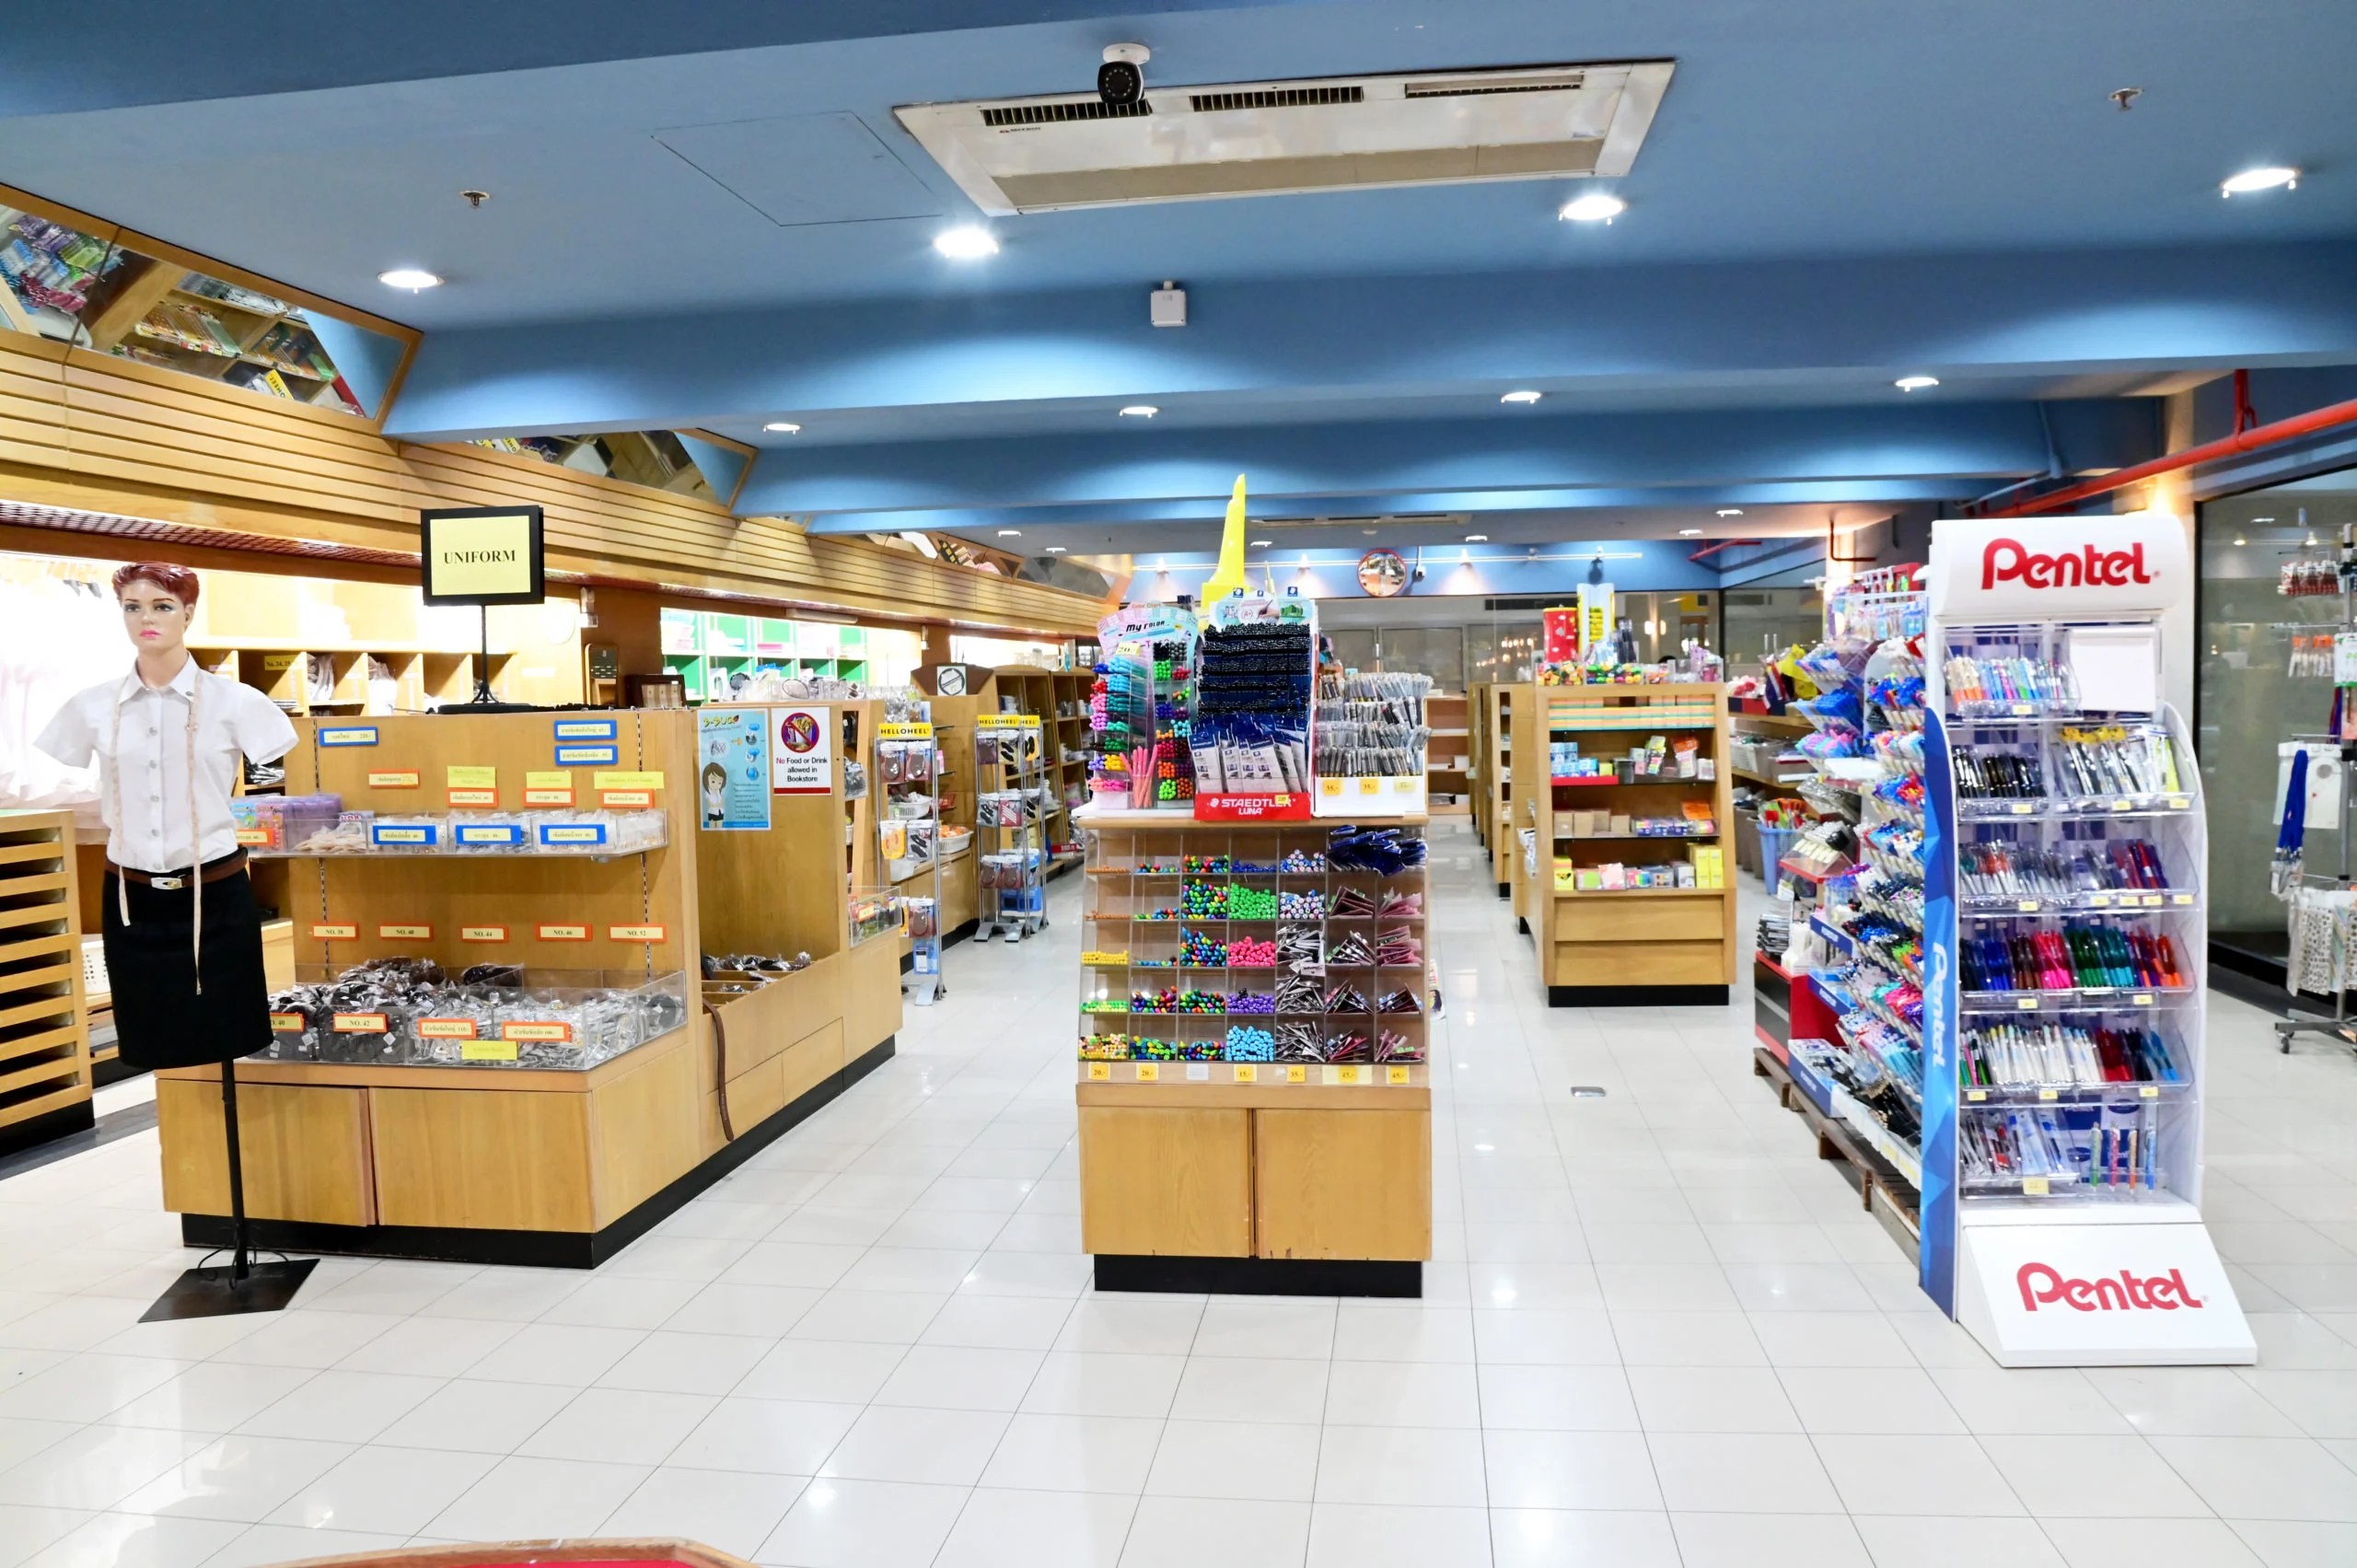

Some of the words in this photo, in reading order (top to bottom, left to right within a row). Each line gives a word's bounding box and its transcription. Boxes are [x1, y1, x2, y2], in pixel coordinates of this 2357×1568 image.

[444, 550, 516, 564] UNIFORM
[1981, 538, 2151, 590] Pentel
[880, 727, 928, 736] HELLOHEEL
[1933, 942, 1948, 1068] Pentel
[2016, 1262, 2203, 1312] Pentel
